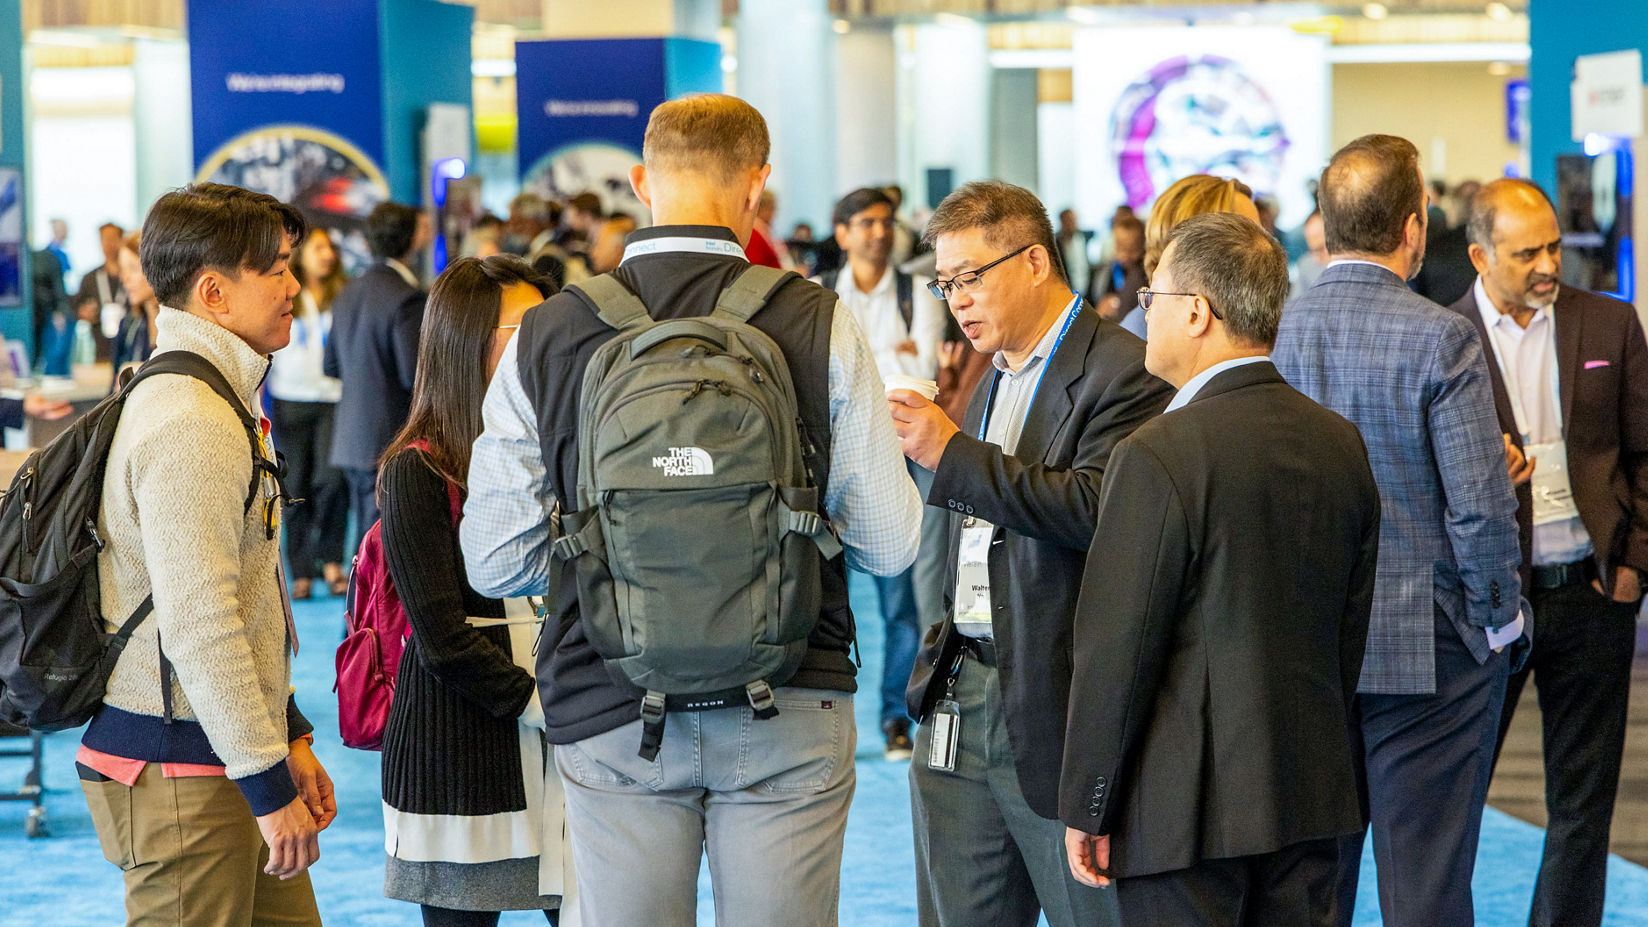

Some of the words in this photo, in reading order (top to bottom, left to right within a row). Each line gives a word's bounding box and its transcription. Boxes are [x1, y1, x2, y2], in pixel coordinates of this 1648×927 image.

[668, 447, 692, 457] THE
[652, 456, 692, 467] NORTH
[663, 466, 693, 476] FACE
